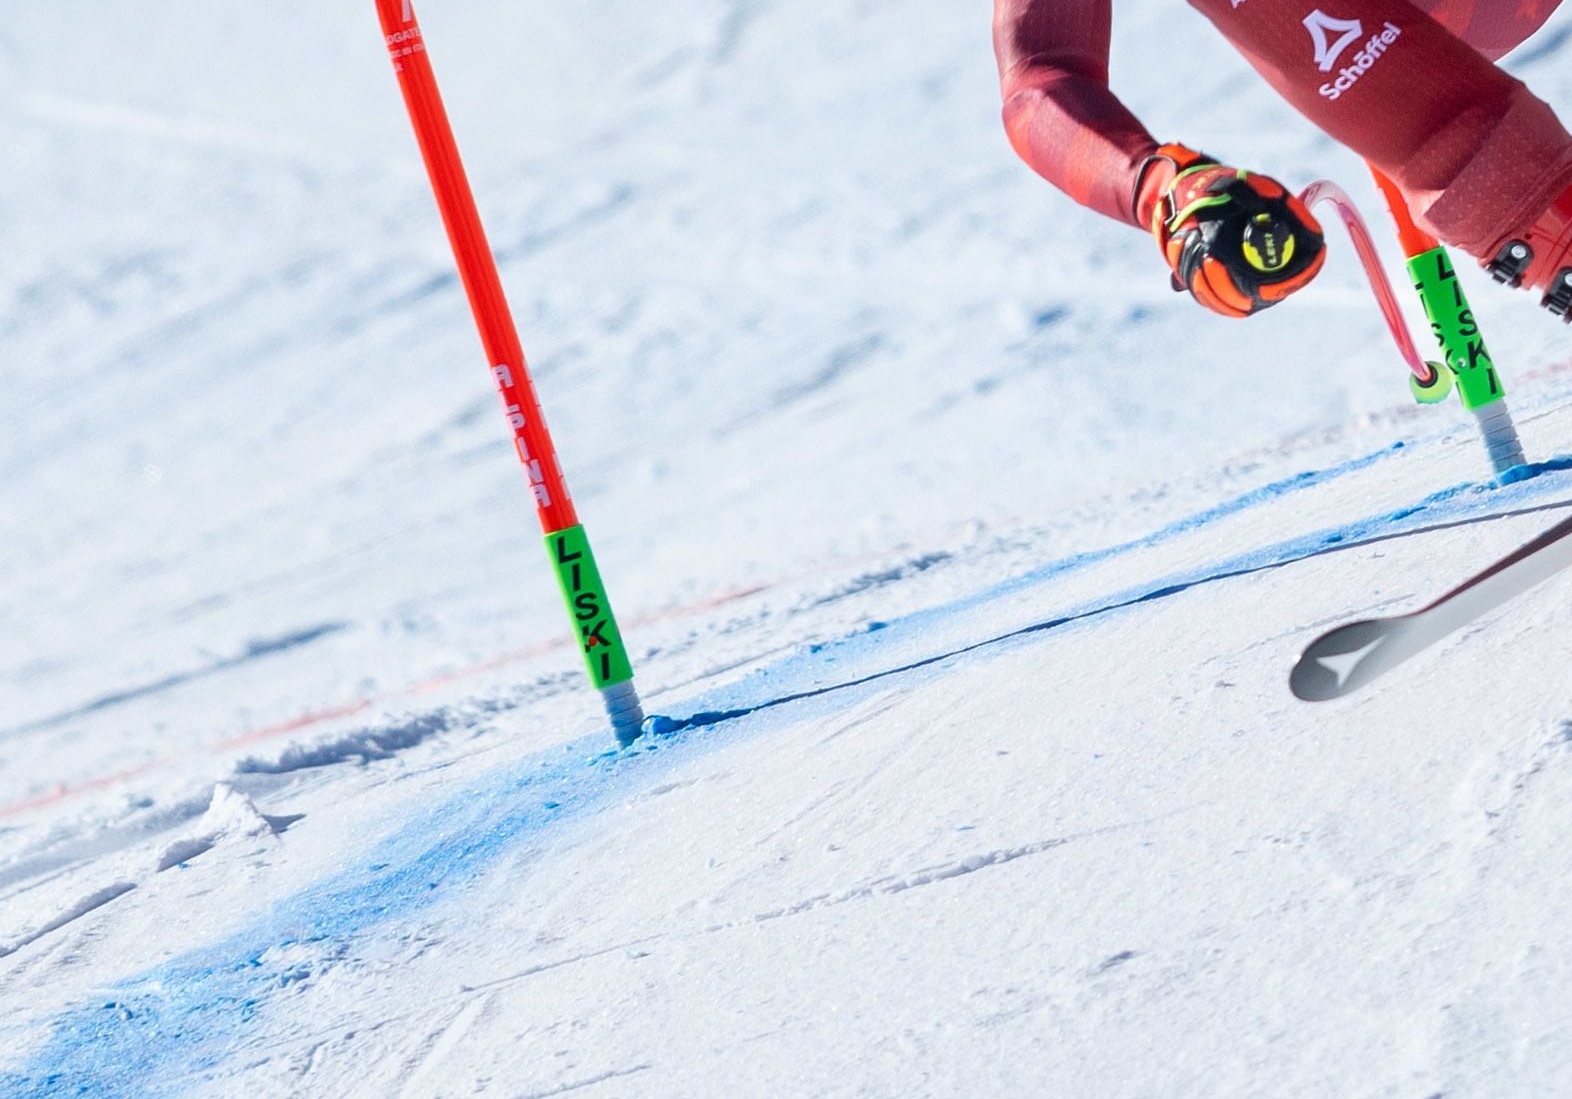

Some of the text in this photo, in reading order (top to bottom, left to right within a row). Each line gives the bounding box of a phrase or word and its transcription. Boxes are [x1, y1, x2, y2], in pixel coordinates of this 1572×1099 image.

[1264, 233, 1277, 264] LEKI
[1438, 255, 1497, 394] LISKI
[557, 537, 612, 682] LISKI
